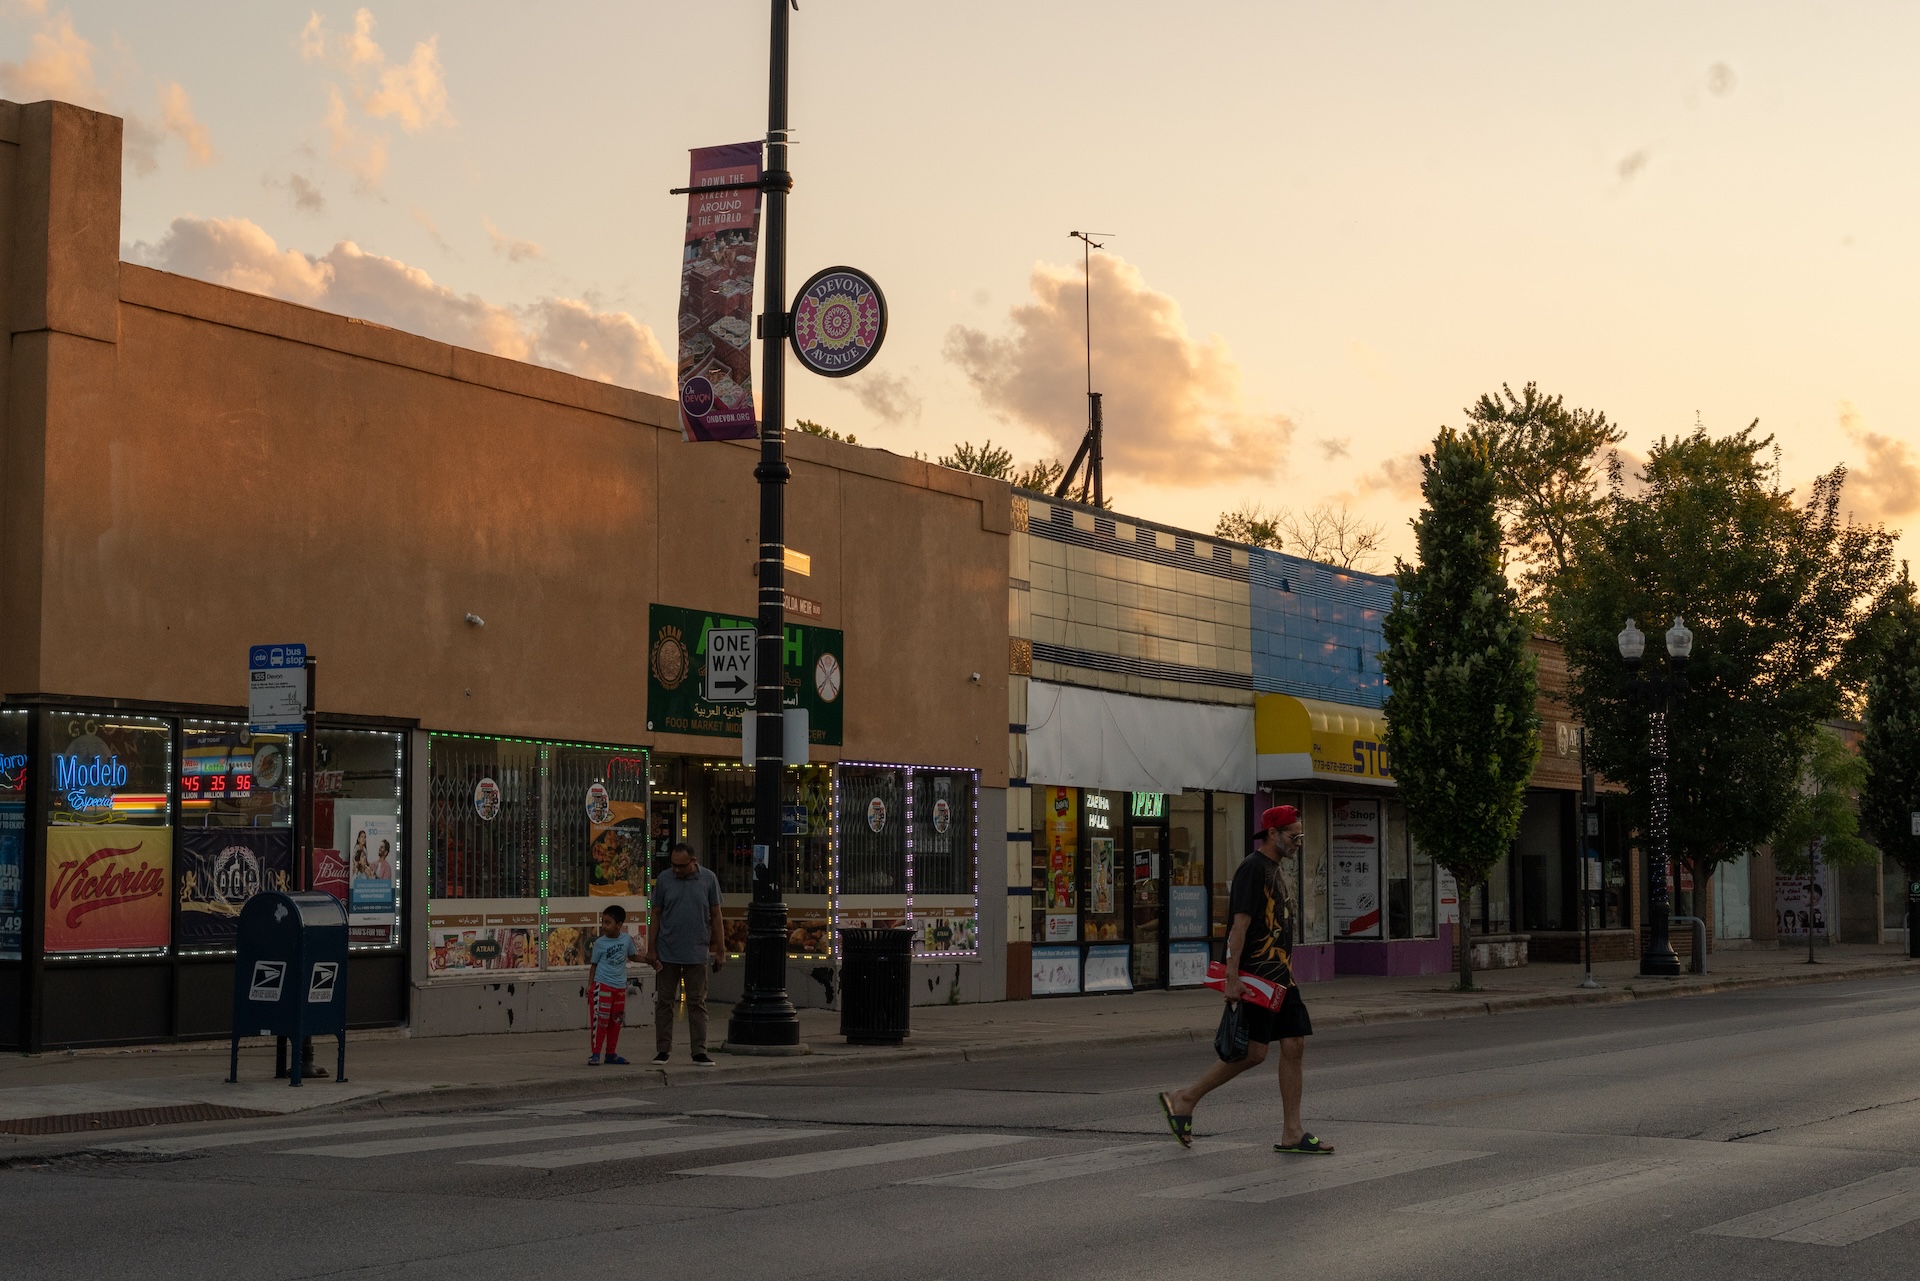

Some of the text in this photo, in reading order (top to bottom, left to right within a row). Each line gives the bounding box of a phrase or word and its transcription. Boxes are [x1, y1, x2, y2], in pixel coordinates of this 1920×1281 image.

[702, 174, 744, 187] DOWN THE
[699, 200, 742, 213] AROUND
[698, 212, 742, 226] THE WORLD
[816, 278, 864, 298] DEVON
[811, 347, 860, 364] AVENUE
[685, 394, 710, 404] DEVON
[706, 412, 750, 424] ONDEVON.ORG
[714, 635, 750, 651] ONE
[286, 648, 302, 656] bus
[286, 656, 304, 666] stop
[712, 655, 750, 672] WAY
[666, 716, 688, 729] FOOD
[690, 719, 723, 733] MARKET
[1353, 740, 1389, 776] STO
[57, 754, 128, 790] Modelo
[204, 763, 224, 772] Lotto
[236, 775, 251, 790] 96
[68, 788, 116, 812] Especial
[1350, 810, 1376, 821] Shop
[50, 841, 164, 929] Victoria
[1172, 890, 1200, 900] Customer
[1175, 906, 1197, 918] Parking
[366, 928, 376, 936] FOR
[1172, 924, 1178, 933] in
[1179, 924, 1188, 933] the
